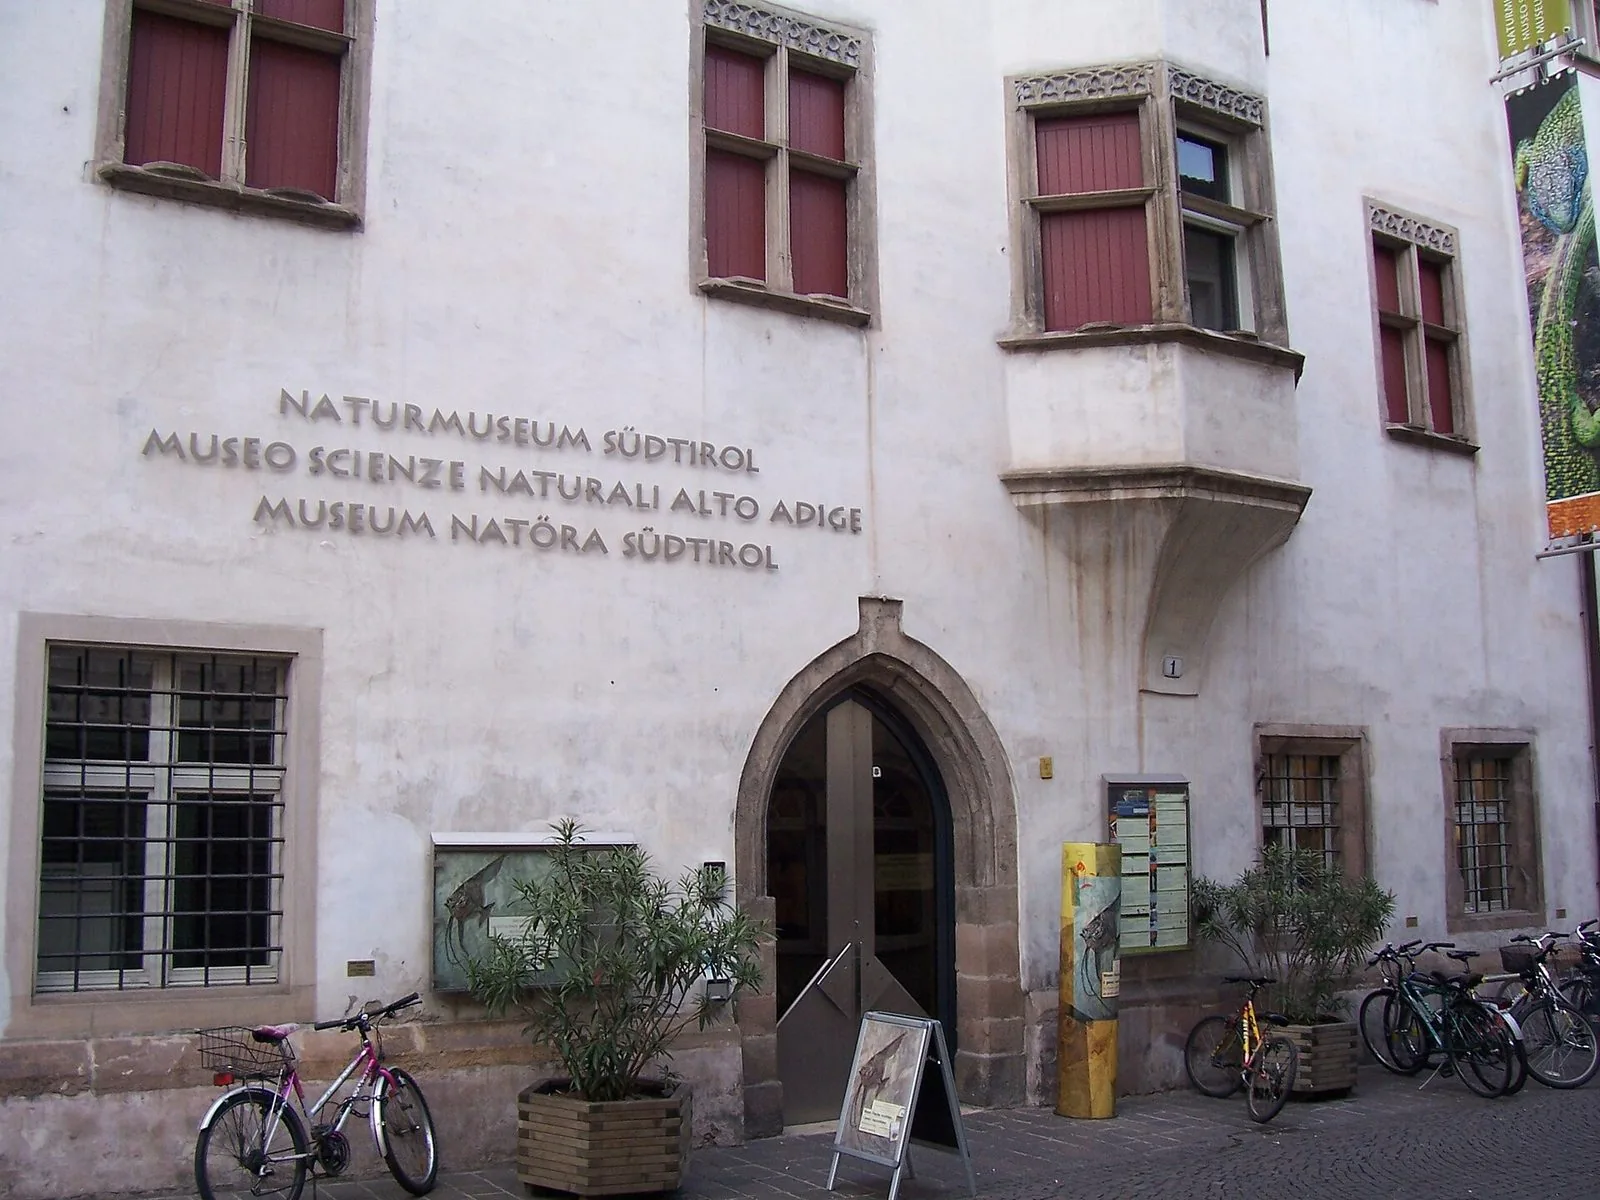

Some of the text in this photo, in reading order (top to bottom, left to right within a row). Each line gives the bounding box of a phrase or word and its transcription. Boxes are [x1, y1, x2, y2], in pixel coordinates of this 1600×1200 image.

[1520, 4, 1531, 40] MUSEO
[279, 387, 760, 473] NATURMUSEUM SÜDTIROL
[142, 427, 862, 533] MUSEO SCIENZE NATURALI ALTO ADIGE
[253, 495, 780, 570] MUSEUM NATÖRA SÜDTIROL
[1170, 660, 1176, 675] 1
